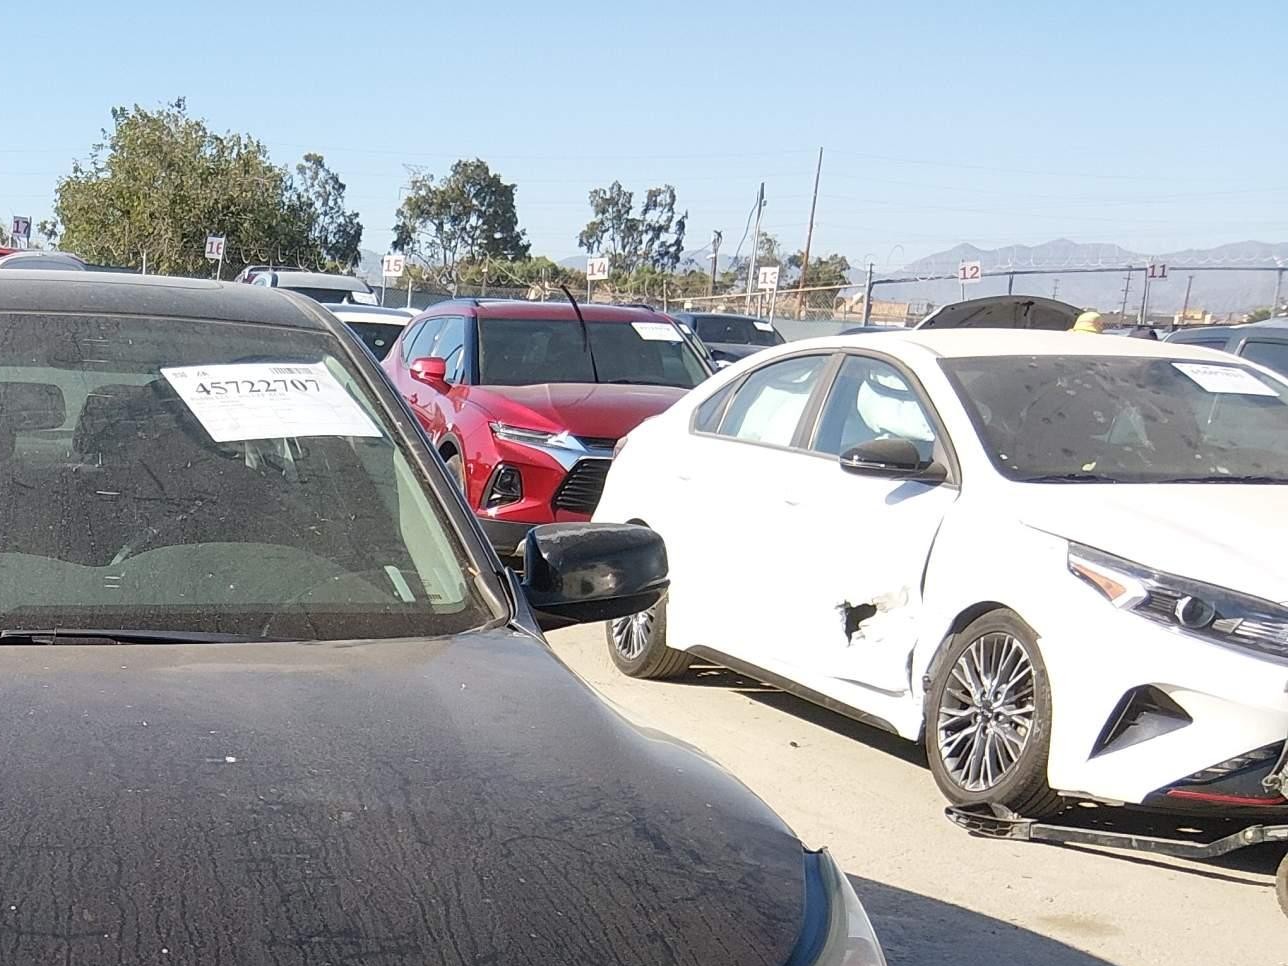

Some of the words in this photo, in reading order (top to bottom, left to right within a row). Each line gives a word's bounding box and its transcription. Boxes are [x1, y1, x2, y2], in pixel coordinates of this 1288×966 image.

[13, 219, 30, 234] 17
[384, 259, 402, 273] 15
[588, 262, 606, 276] 14
[959, 266, 979, 280] 12
[1148, 264, 1167, 278] 11
[196, 379, 320, 395] 45722707
